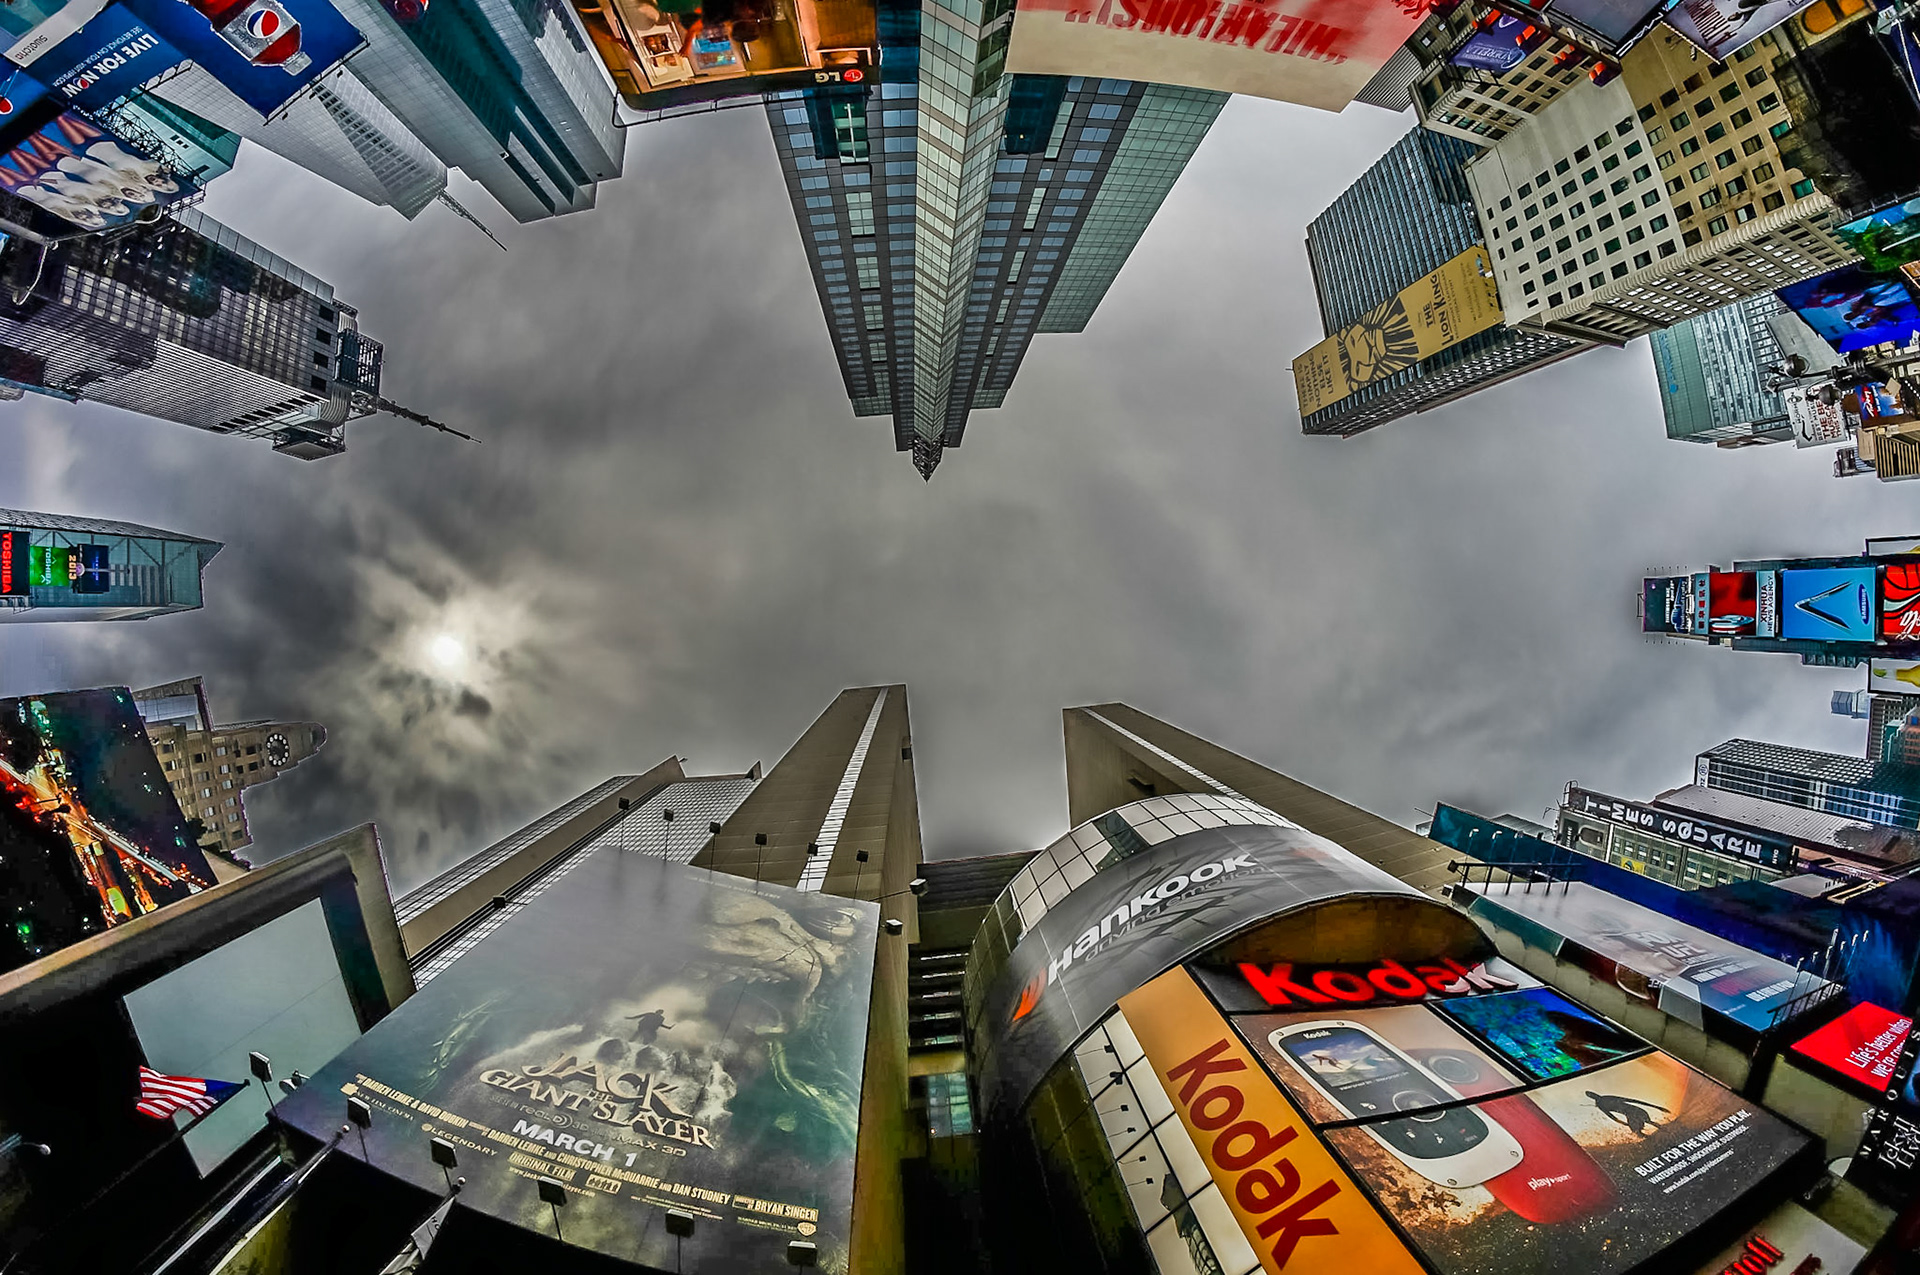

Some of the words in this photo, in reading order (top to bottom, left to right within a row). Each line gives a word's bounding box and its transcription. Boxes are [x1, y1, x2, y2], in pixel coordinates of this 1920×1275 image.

[121, 33, 159, 58] LIVE
[93, 52, 127, 75] FOR
[1430, 275, 1446, 310] KING
[1423, 303, 1433, 328] THE
[1438, 311, 1454, 345] LION
[1300, 377, 1308, 408] THERE
[1304, 364, 1314, 402] SIMPLY
[1308, 352, 1322, 408] NOTHING
[1317, 364, 1326, 389] ELSE
[1325, 368, 1334, 394] LIKE
[1, 532, 13, 593] TOSHIBA
[68, 555, 77, 580] 2013
[1584, 795, 1654, 827] TIMES
[1662, 819, 1762, 859] SQUARE
[1171, 864, 1267, 909] emotion
[1238, 957, 1520, 1007] Kodak
[1303, 1030, 1331, 1040] Kodak
[1845, 1047, 1875, 1069] Life's
[1865, 1029, 1897, 1056] better
[1888, 1018, 1912, 1036] when
[362, 1078, 392, 1096] DARREN
[387, 1089, 415, 1106] LEMKE
[417, 1102, 441, 1118] DAVID
[438, 1110, 470, 1128] DOBKIN
[521, 1052, 694, 1119] JACK
[586, 1088, 614, 1102] THE
[480, 1069, 583, 1111] GIANT
[592, 1100, 716, 1150] SLAYER
[431, 1126, 499, 1157] LEGENDARY
[512, 1118, 615, 1161] MARCH
[624, 1152, 638, 1167] 1
[661, 1144, 688, 1157] 3D
[1166, 1038, 1341, 1271] Kodak
[1633, 1155, 1665, 1177] BUILT
[1661, 1147, 1685, 1164] FOR
[1680, 1136, 1702, 1154] THE
[1695, 1128, 1720, 1147] WAY
[1713, 1119, 1735, 1134] YOU
[1730, 1108, 1752, 1125] PLAY.
[487, 1129, 521, 1148] DARREN
[516, 1138, 546, 1157] LEMKE
[555, 1151, 613, 1177] CHRISTOPHER
[671, 1183, 692, 1198] DAN
[690, 1187, 731, 1206] STUDNEY
[754, 1200, 785, 1217] BRYAN
[784, 1204, 817, 1221] SINGER
[509, 1153, 551, 1174] ORIGINAL
[551, 1165, 575, 1180] FILM
[1527, 1175, 1551, 1191] play
